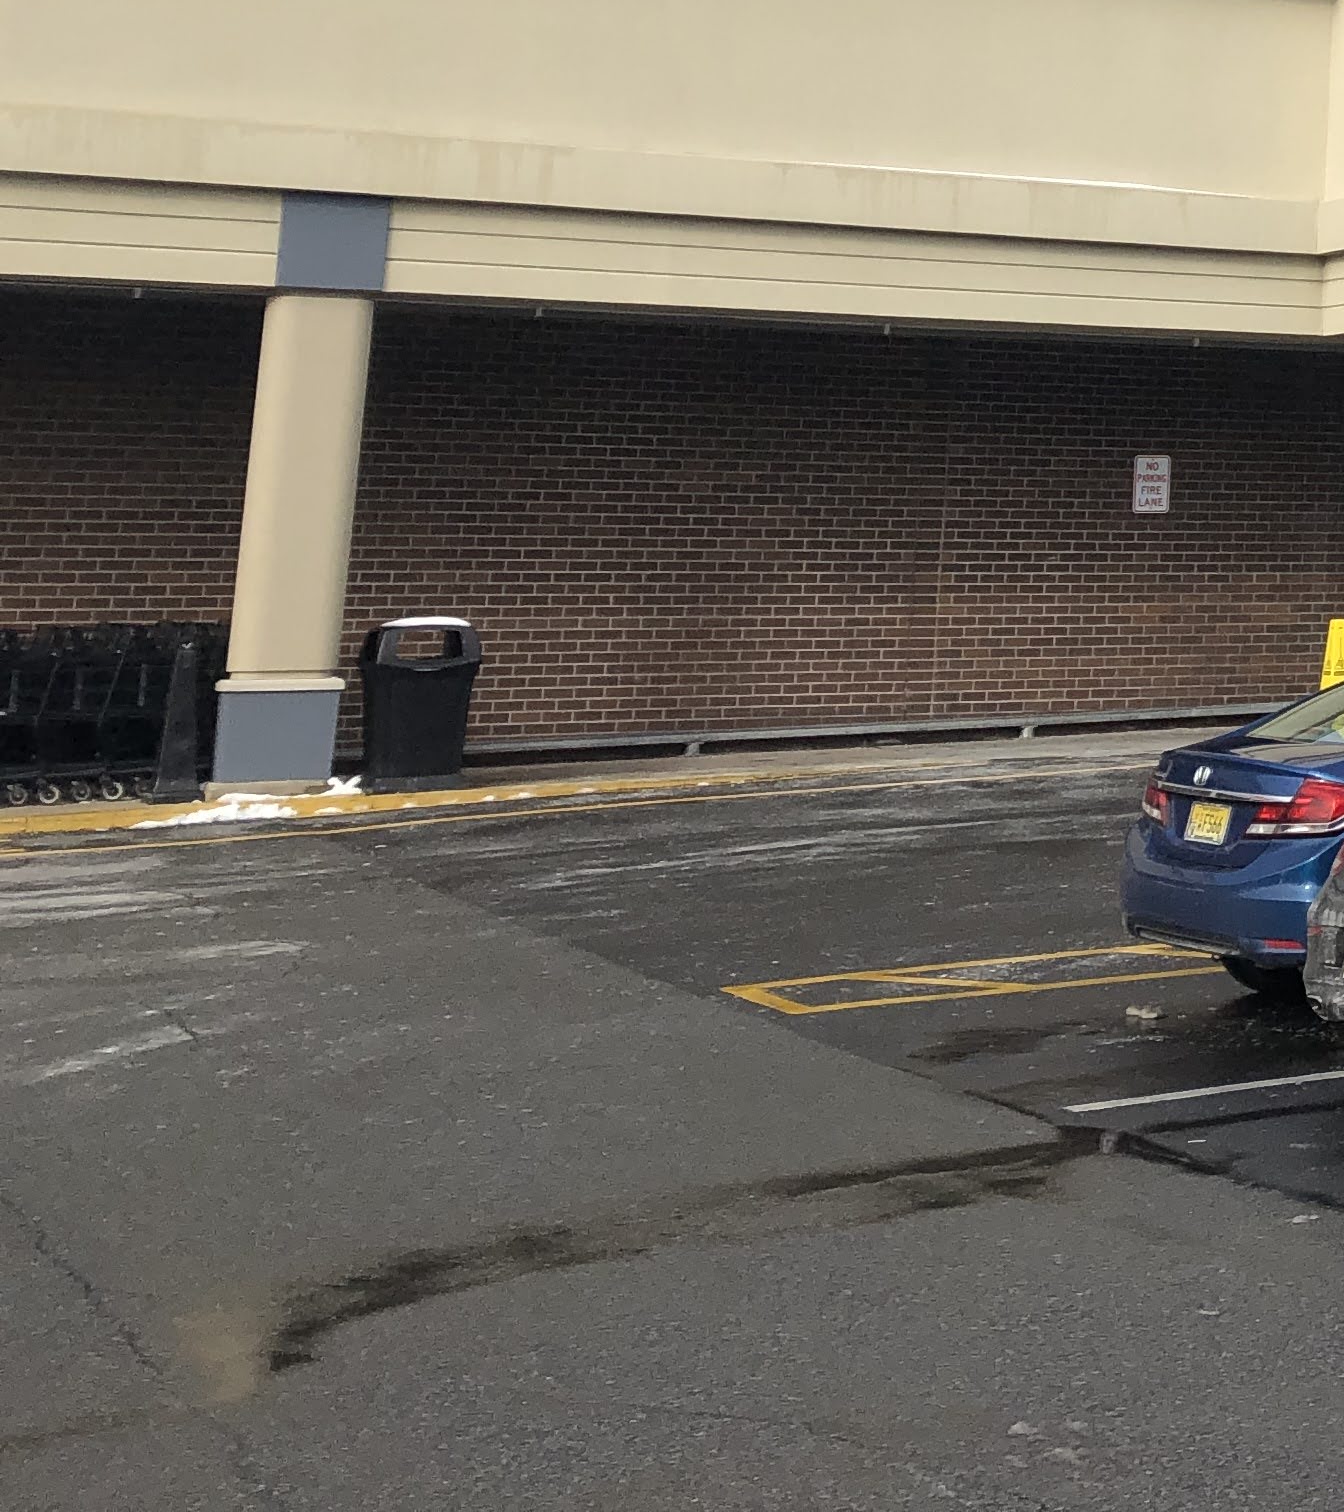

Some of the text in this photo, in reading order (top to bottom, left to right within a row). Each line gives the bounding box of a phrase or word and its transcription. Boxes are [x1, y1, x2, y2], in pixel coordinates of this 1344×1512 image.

[1146, 462, 1159, 471] NO
[1137, 474, 1167, 482] PARKING
[1141, 486, 1162, 494] FIRE
[1138, 498, 1163, 506] LANE
